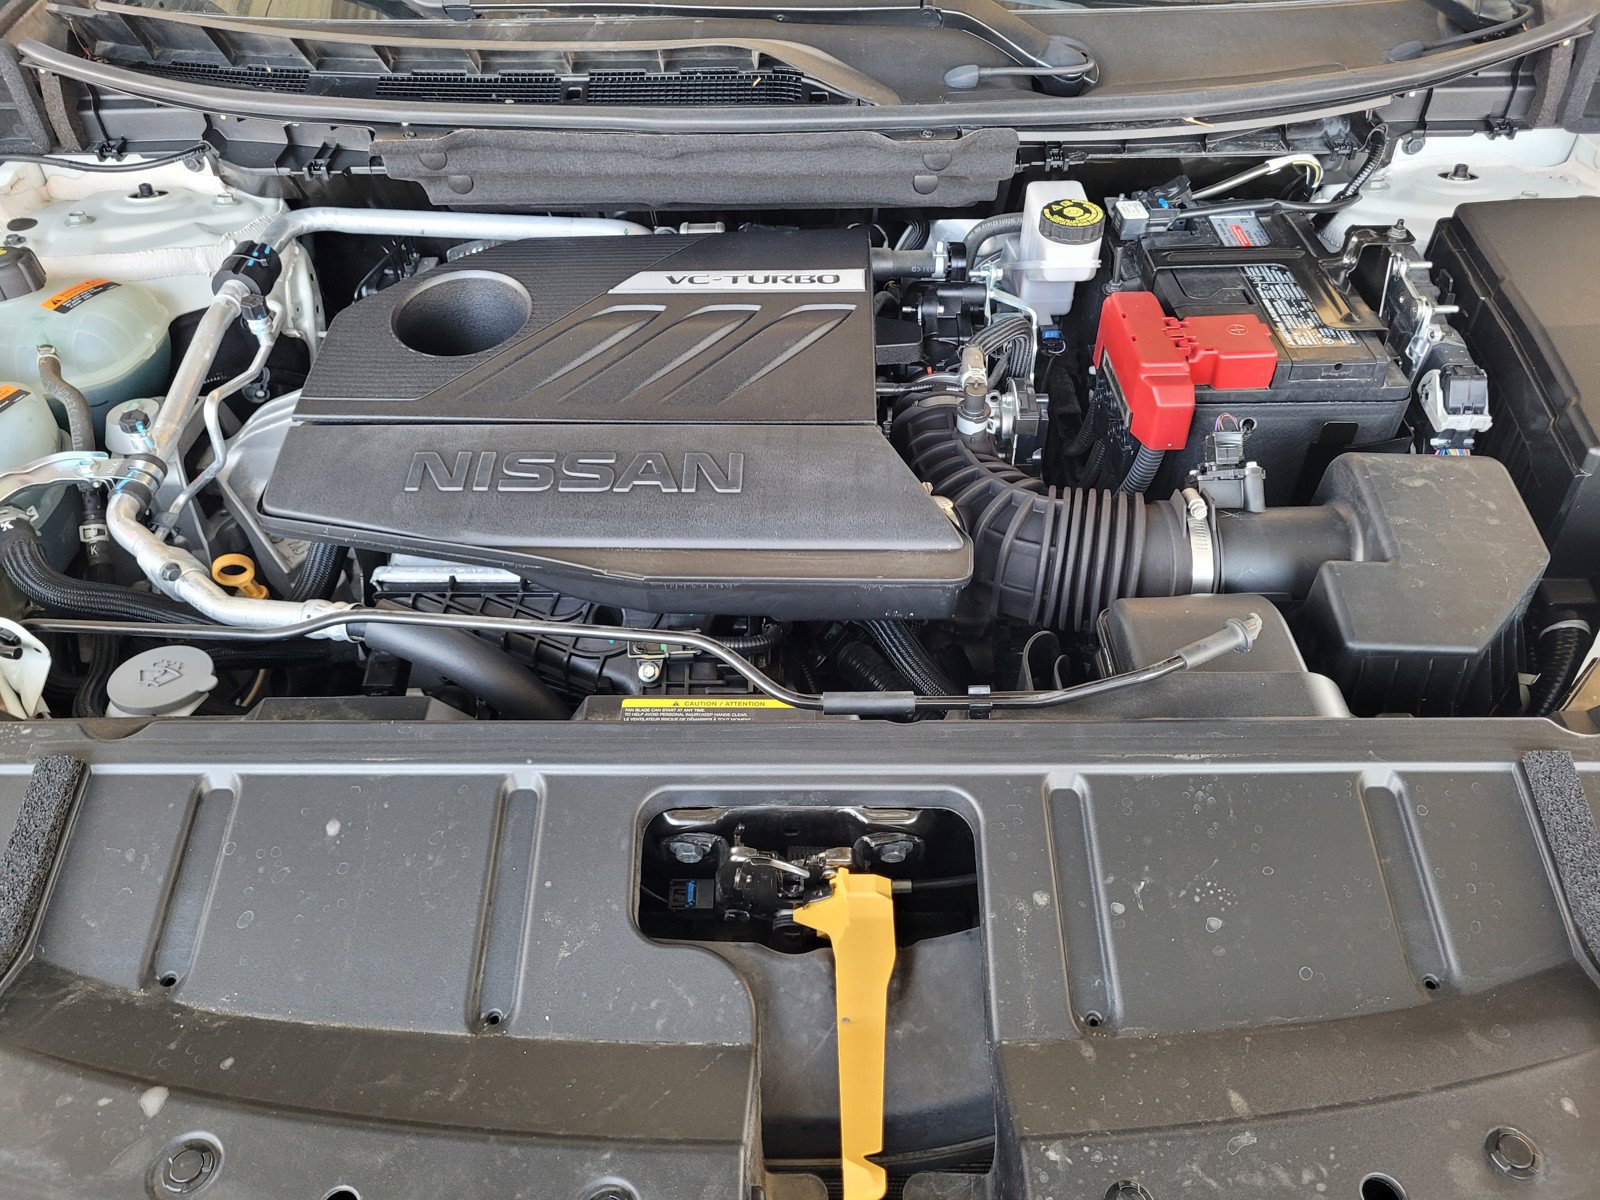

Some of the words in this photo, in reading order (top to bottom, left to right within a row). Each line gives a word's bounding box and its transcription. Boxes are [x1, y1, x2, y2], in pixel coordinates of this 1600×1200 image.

[665, 274, 840, 285] VC-TURBO
[404, 451, 744, 493] NISSAN
[90, 544, 99, 556] K
